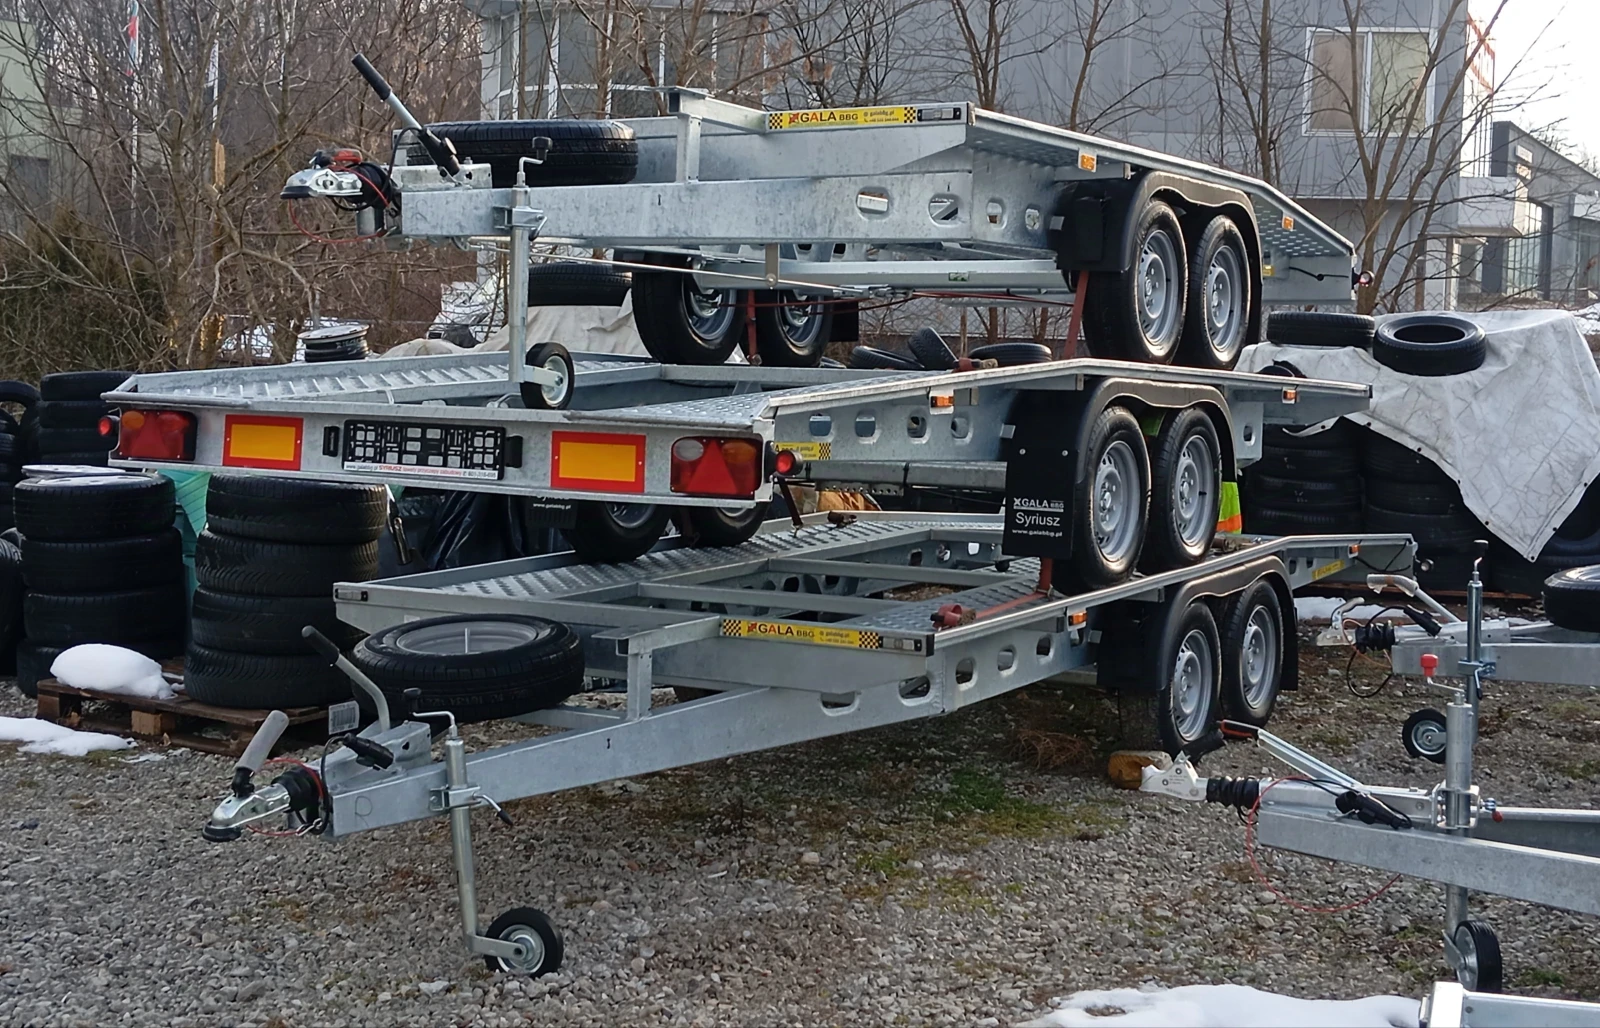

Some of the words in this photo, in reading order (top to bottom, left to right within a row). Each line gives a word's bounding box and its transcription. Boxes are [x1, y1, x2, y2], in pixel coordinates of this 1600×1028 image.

[800, 111, 837, 123] GALA
[839, 113, 859, 121] BBG
[1015, 511, 1061, 527] Syriusz
[758, 623, 795, 636] GALA
[796, 630, 815, 638] BBG
